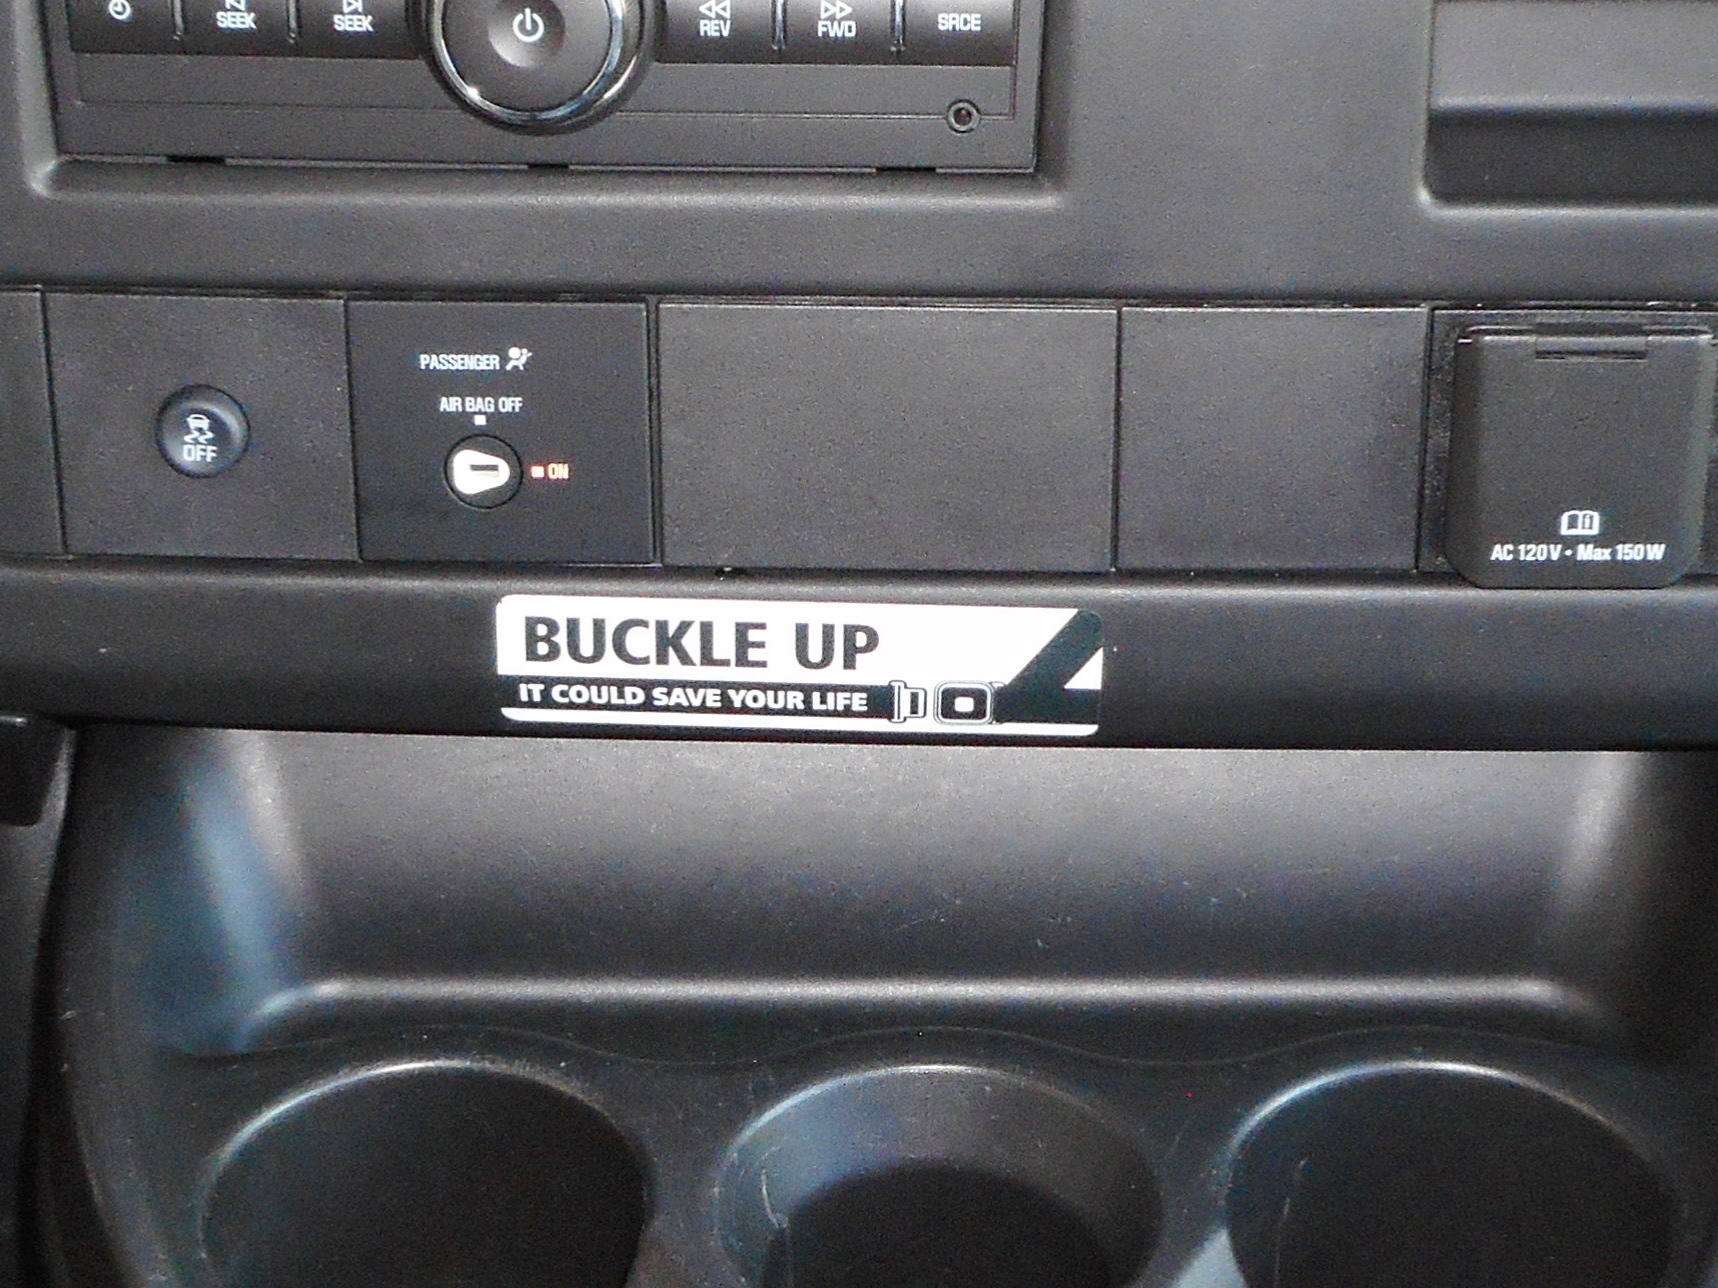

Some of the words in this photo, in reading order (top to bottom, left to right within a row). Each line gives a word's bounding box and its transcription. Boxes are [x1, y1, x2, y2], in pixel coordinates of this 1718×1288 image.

[216, 11, 257, 30] SEEK
[333, 14, 374, 32] SEEK
[699, 19, 731, 38] REV
[817, 20, 857, 38] FWD
[937, 13, 982, 32] SRCE
[419, 353, 501, 371] PASSENGER
[439, 396, 463, 413] AIR
[465, 396, 495, 413] BAG
[498, 396, 524, 413] OFF
[183, 444, 218, 462] OFF
[547, 463, 570, 480] ON
[1490, 543, 1514, 561] AC
[1576, 543, 1612, 561] Max
[524, 615, 769, 669] BUCKLE
[795, 622, 881, 671] UP
[519, 683, 543, 703] IT
[551, 683, 644, 707] COULD
[653, 685, 722, 709] SAVE
[727, 688, 805, 711] YOUR
[812, 690, 868, 712] LIFE
